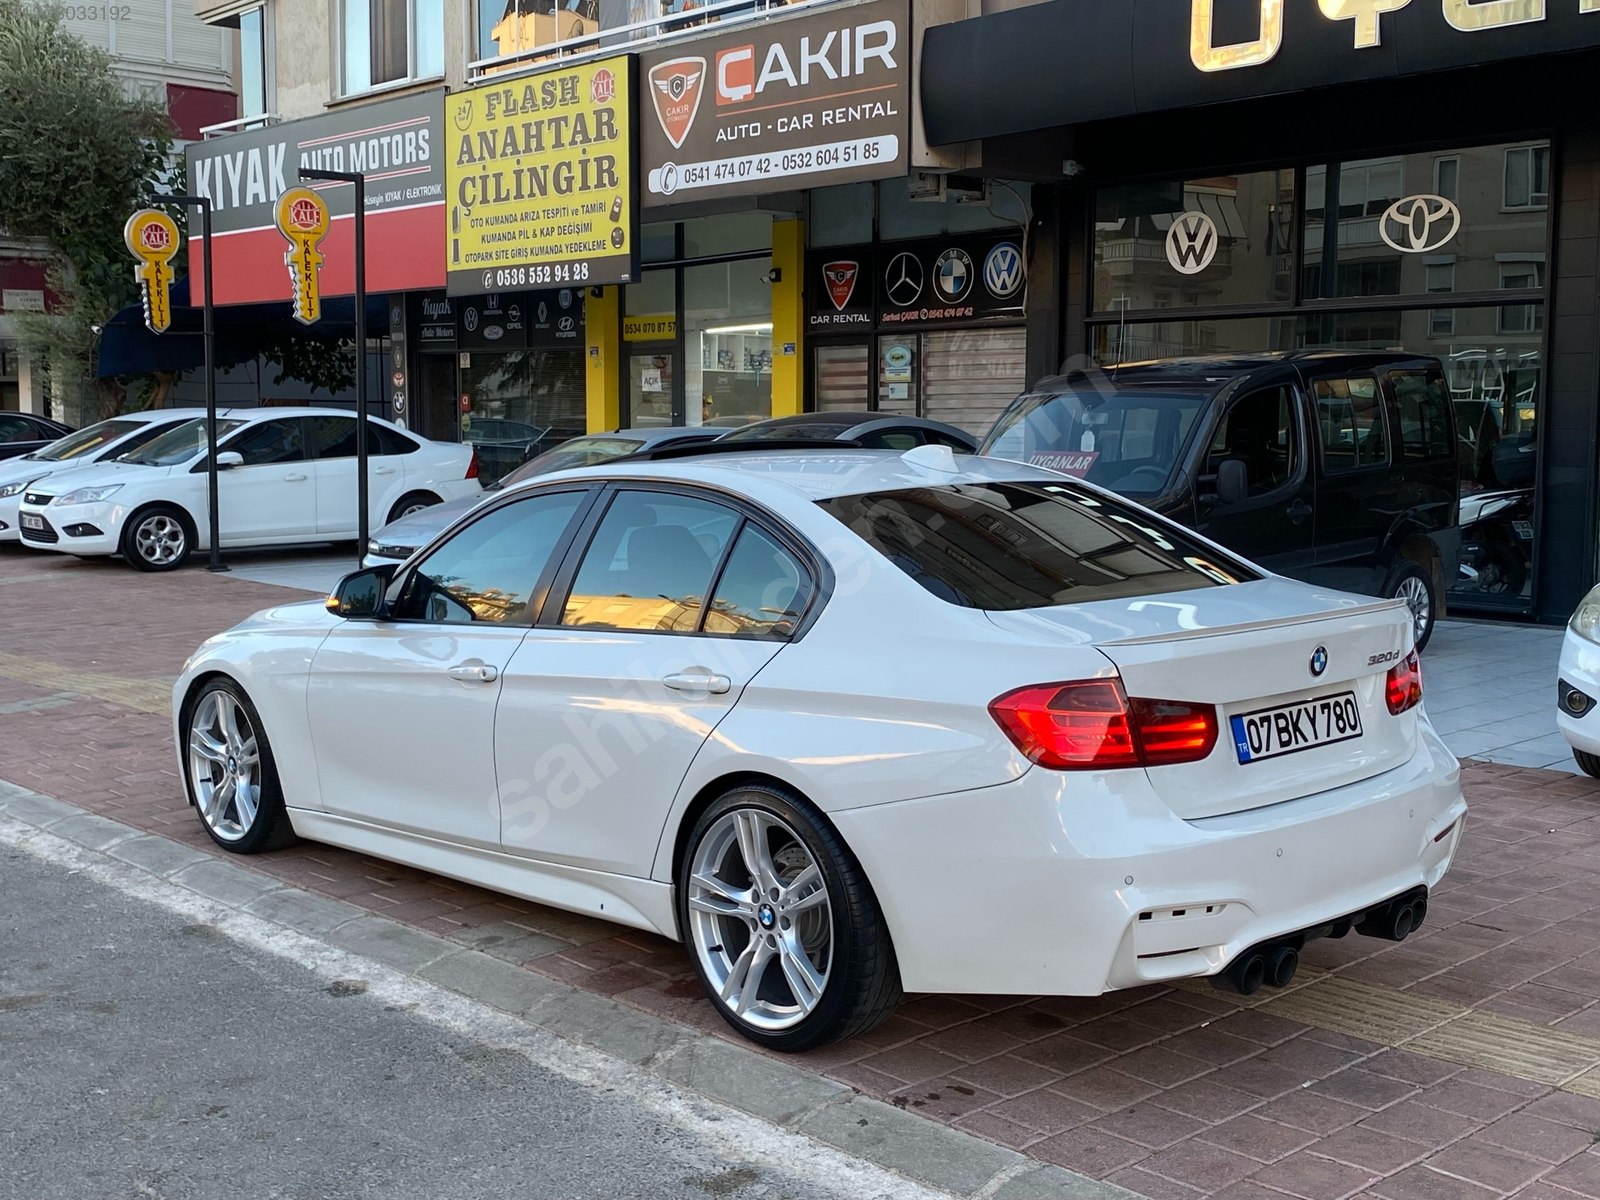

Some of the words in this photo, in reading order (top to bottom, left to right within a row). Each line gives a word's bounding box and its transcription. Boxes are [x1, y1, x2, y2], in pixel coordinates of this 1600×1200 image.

[485, 75, 580, 120] FLASH
[590, 78, 616, 99] KALE
[715, 122, 761, 143] AUTO
[777, 113, 814, 133] CAR
[822, 101, 898, 126] RENTAL
[456, 107, 619, 165] ANAHTAR
[300, 145, 344, 173] AUTO
[349, 128, 430, 173] MOTORS
[684, 166, 710, 185] 0541
[714, 162, 735, 181] 474
[738, 160, 753, 177] 07
[756, 157, 771, 174] 42
[782, 153, 812, 171] 0532
[816, 148, 839, 165] 604
[843, 145, 858, 162] 51
[863, 142, 880, 159] 85
[195, 142, 287, 214] KIYAK
[458, 148, 619, 217] ÇİLİNGİR
[289, 206, 321, 226] KALE
[470, 217, 484, 228] OTO
[485, 213, 518, 227] KUMANDA
[519, 210, 540, 223] ARIZA
[571, 208, 579, 216] ve
[141, 230, 171, 248] KALE
[481, 231, 517, 244] KUMANDA
[518, 228, 530, 240] PİL
[540, 226, 556, 237] KAP
[465, 250, 494, 264] OTOPARK
[529, 243, 563, 257] KUMANDA
[564, 239, 607, 254] YEDEKLEME
[496, 268, 526, 287] 0536
[528, 266, 552, 285] 552
[554, 264, 570, 283] 94
[573, 262, 589, 281] 28
[506, 322, 523, 330] OPEL
[624, 323, 641, 335] 0534
[642, 322, 656, 334] 070
[657, 322, 666, 333] 87
[667, 321, 676, 333] 57
[810, 315, 830, 325] CAR
[833, 313, 871, 324] RENTAL
[643, 376, 660, 387] AÇIK
[1028, 455, 1092, 470] UYGANLAR
[1367, 649, 1400, 666] 320d
[1246, 697, 1358, 754] 07BKY780
[1238, 743, 1249, 753] TR
